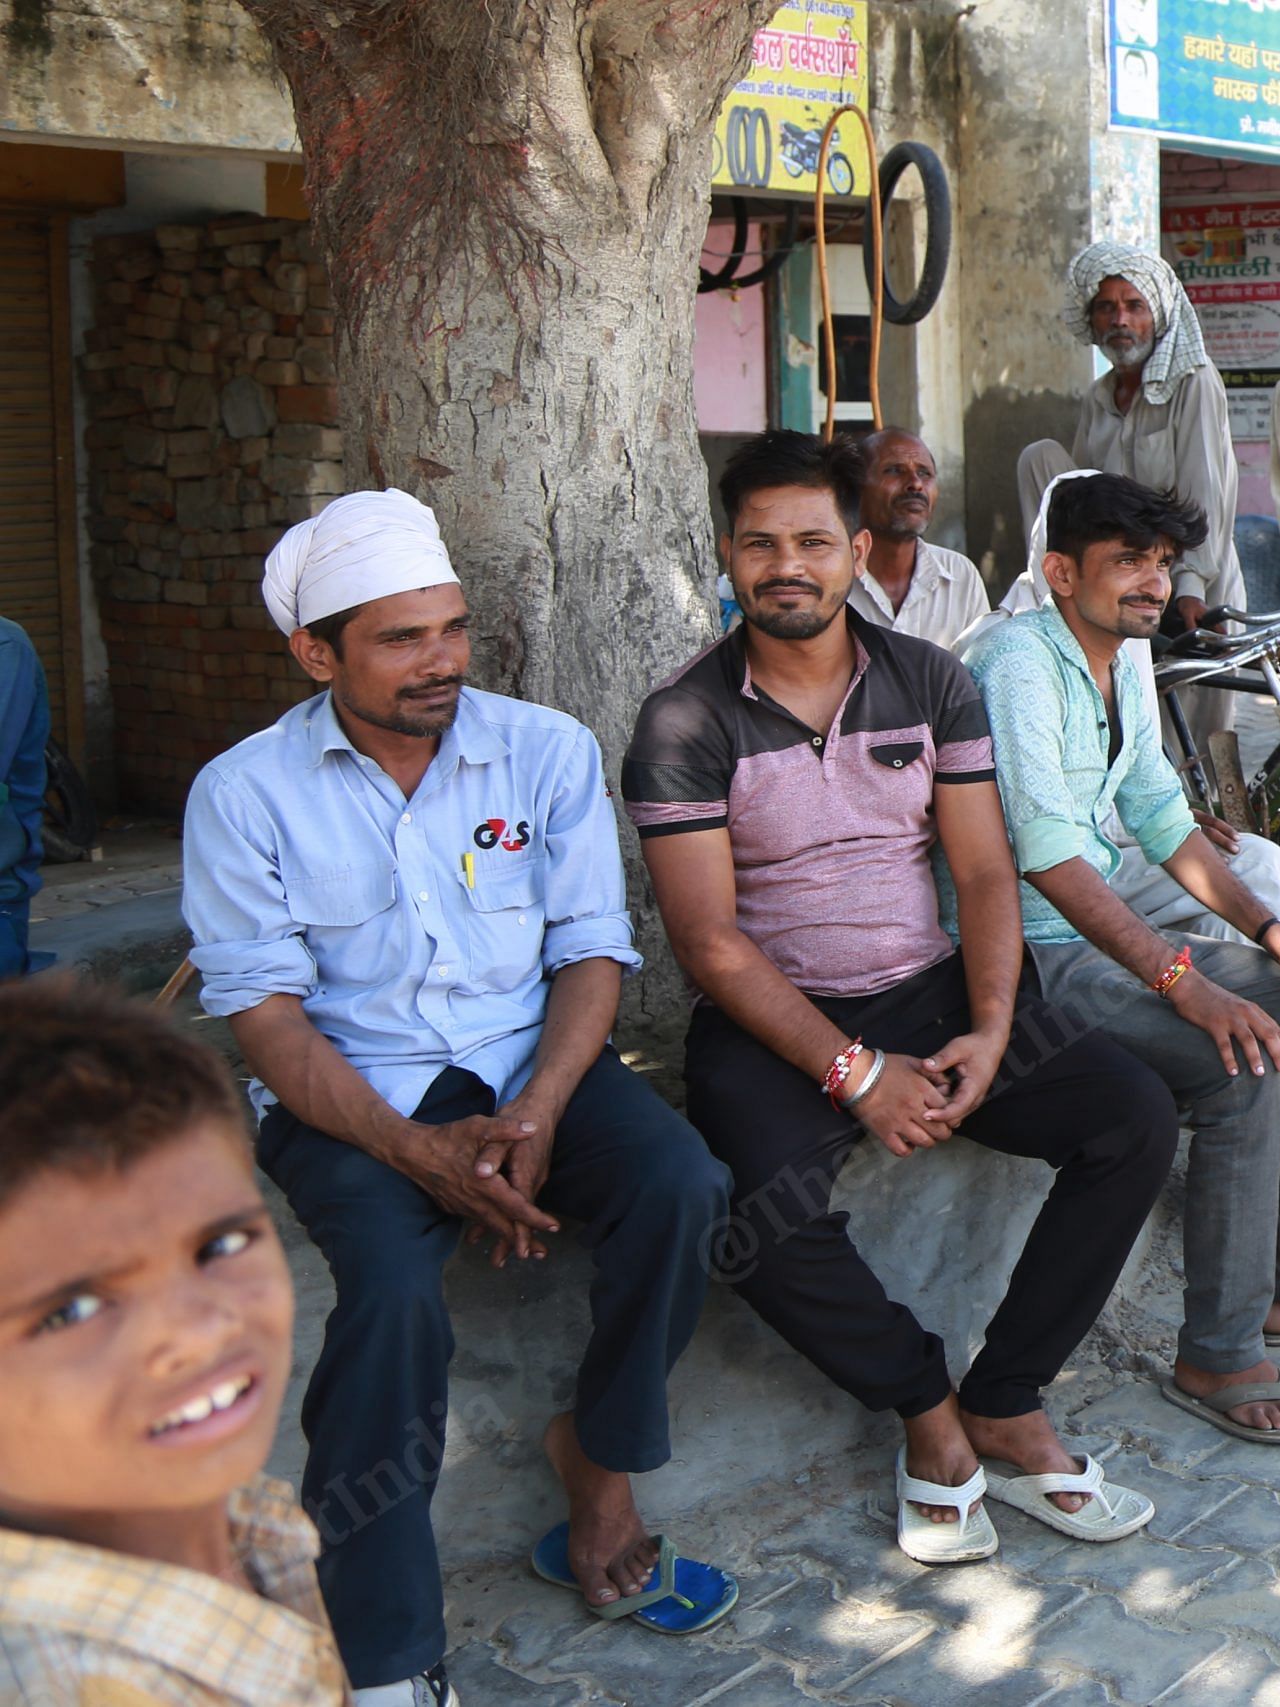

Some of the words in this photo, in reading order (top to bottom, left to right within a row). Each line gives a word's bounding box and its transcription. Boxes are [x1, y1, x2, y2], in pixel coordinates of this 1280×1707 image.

[1183, 34, 1225, 62] हमारे
[1212, 76, 1259, 103] मास्क
[1246, 227, 1266, 245] भी
[473, 818, 531, 852] G4S
